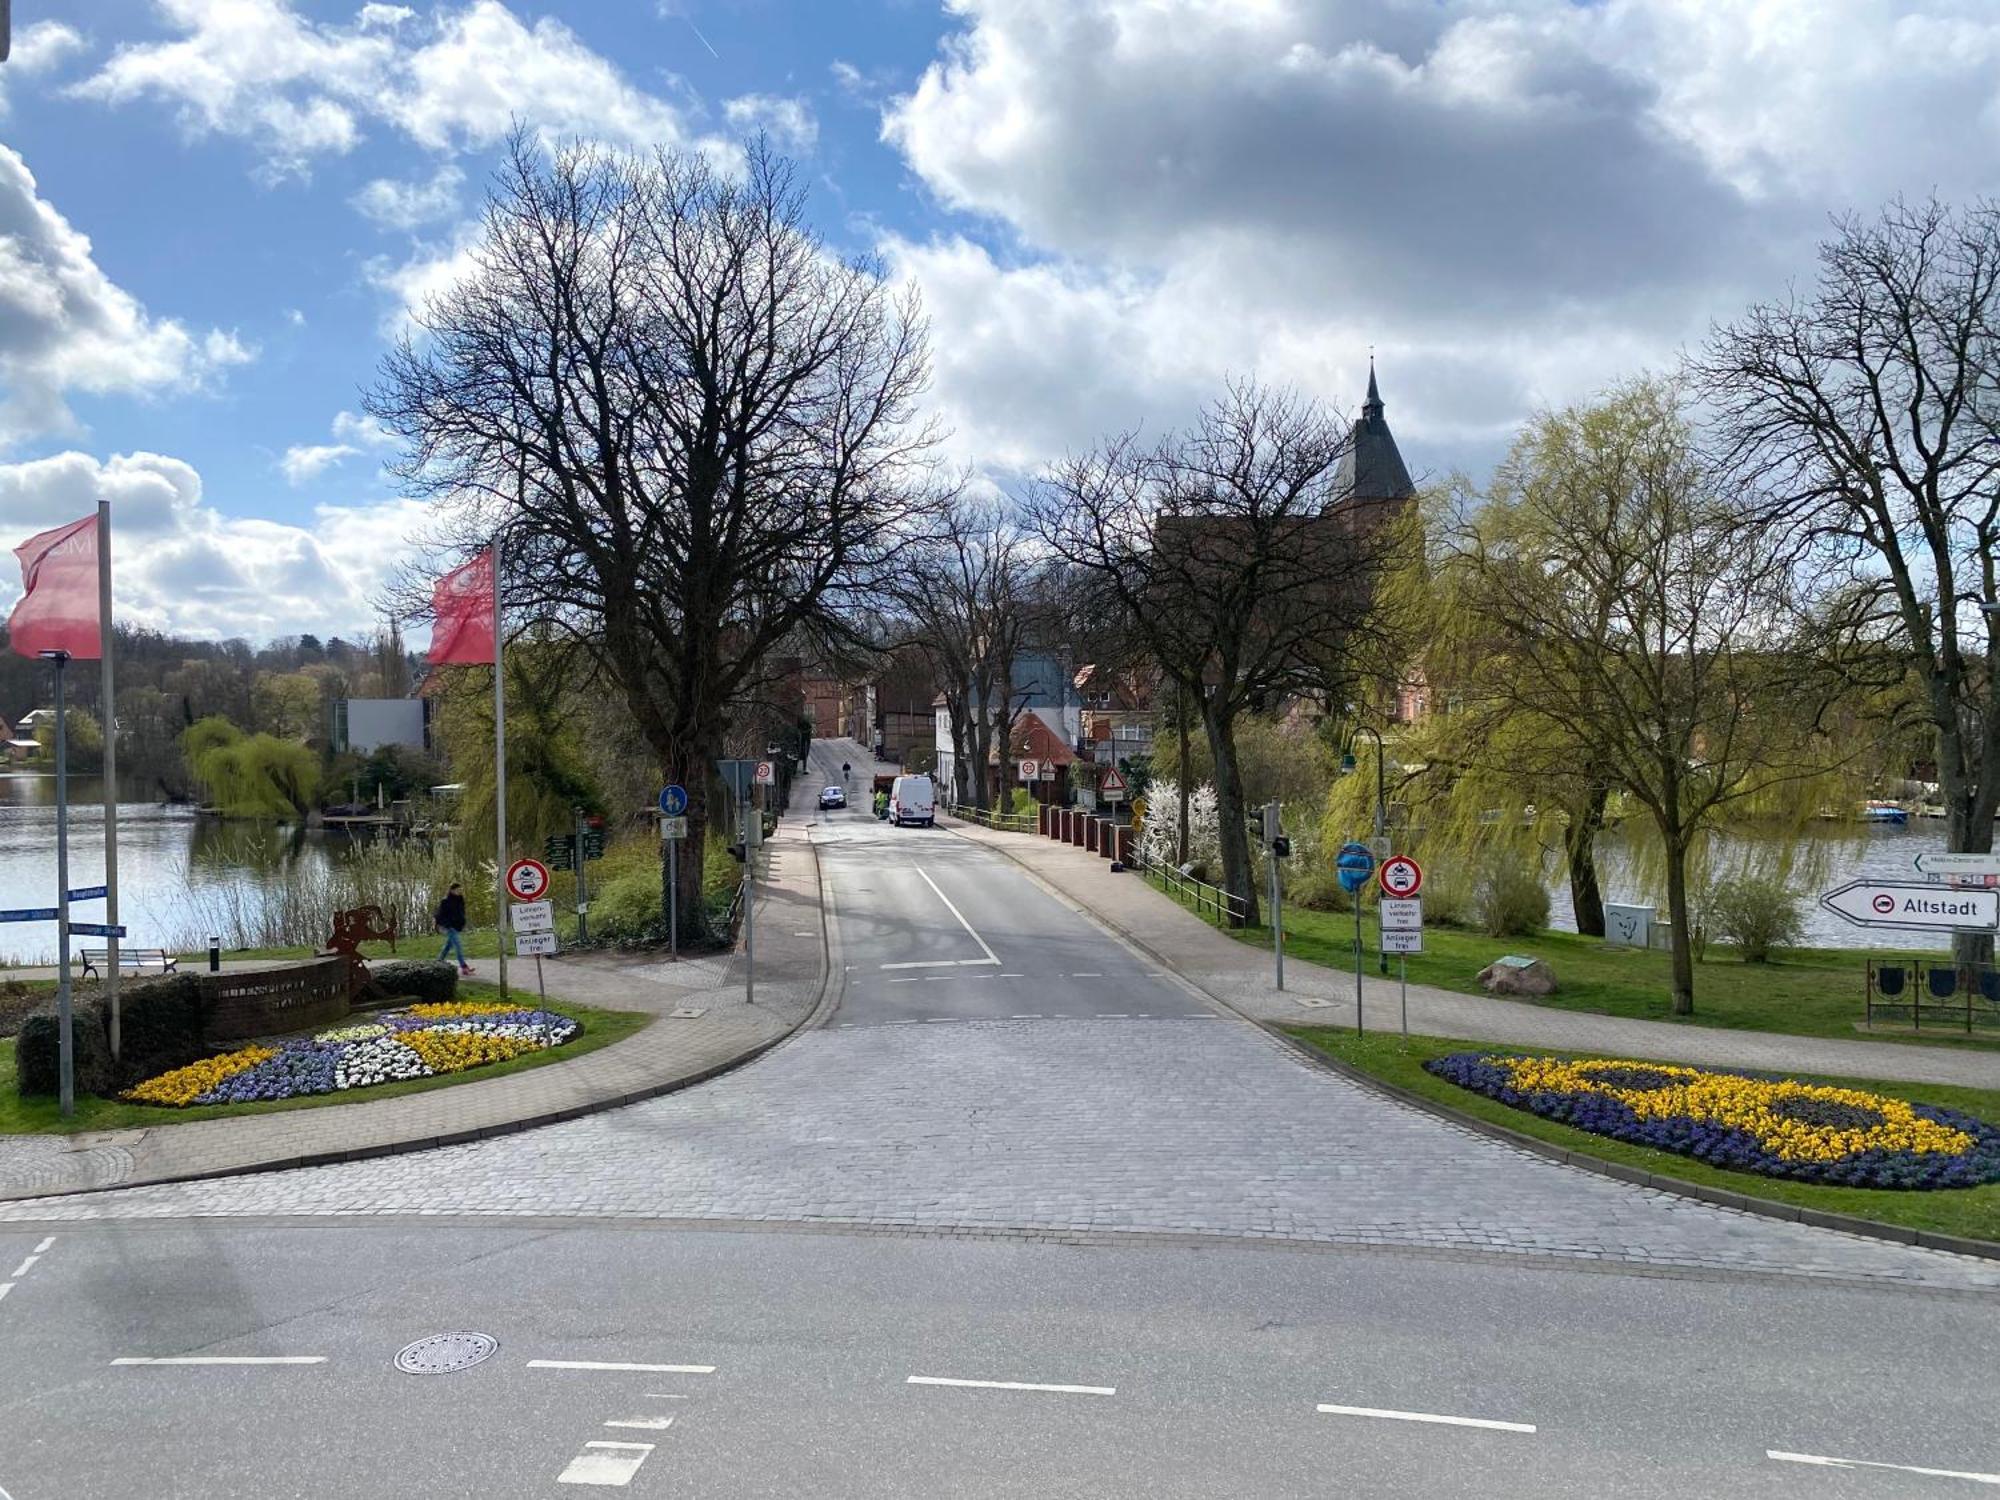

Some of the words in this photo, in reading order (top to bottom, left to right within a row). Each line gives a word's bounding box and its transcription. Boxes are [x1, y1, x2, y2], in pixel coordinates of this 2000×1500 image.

[1903, 898, 1977, 916] Altstadt
[519, 936, 551, 945] Anlieger
[1385, 934, 1418, 943] Anlieger
[530, 945, 544, 953] frei
[1395, 942, 1409, 950] frei
